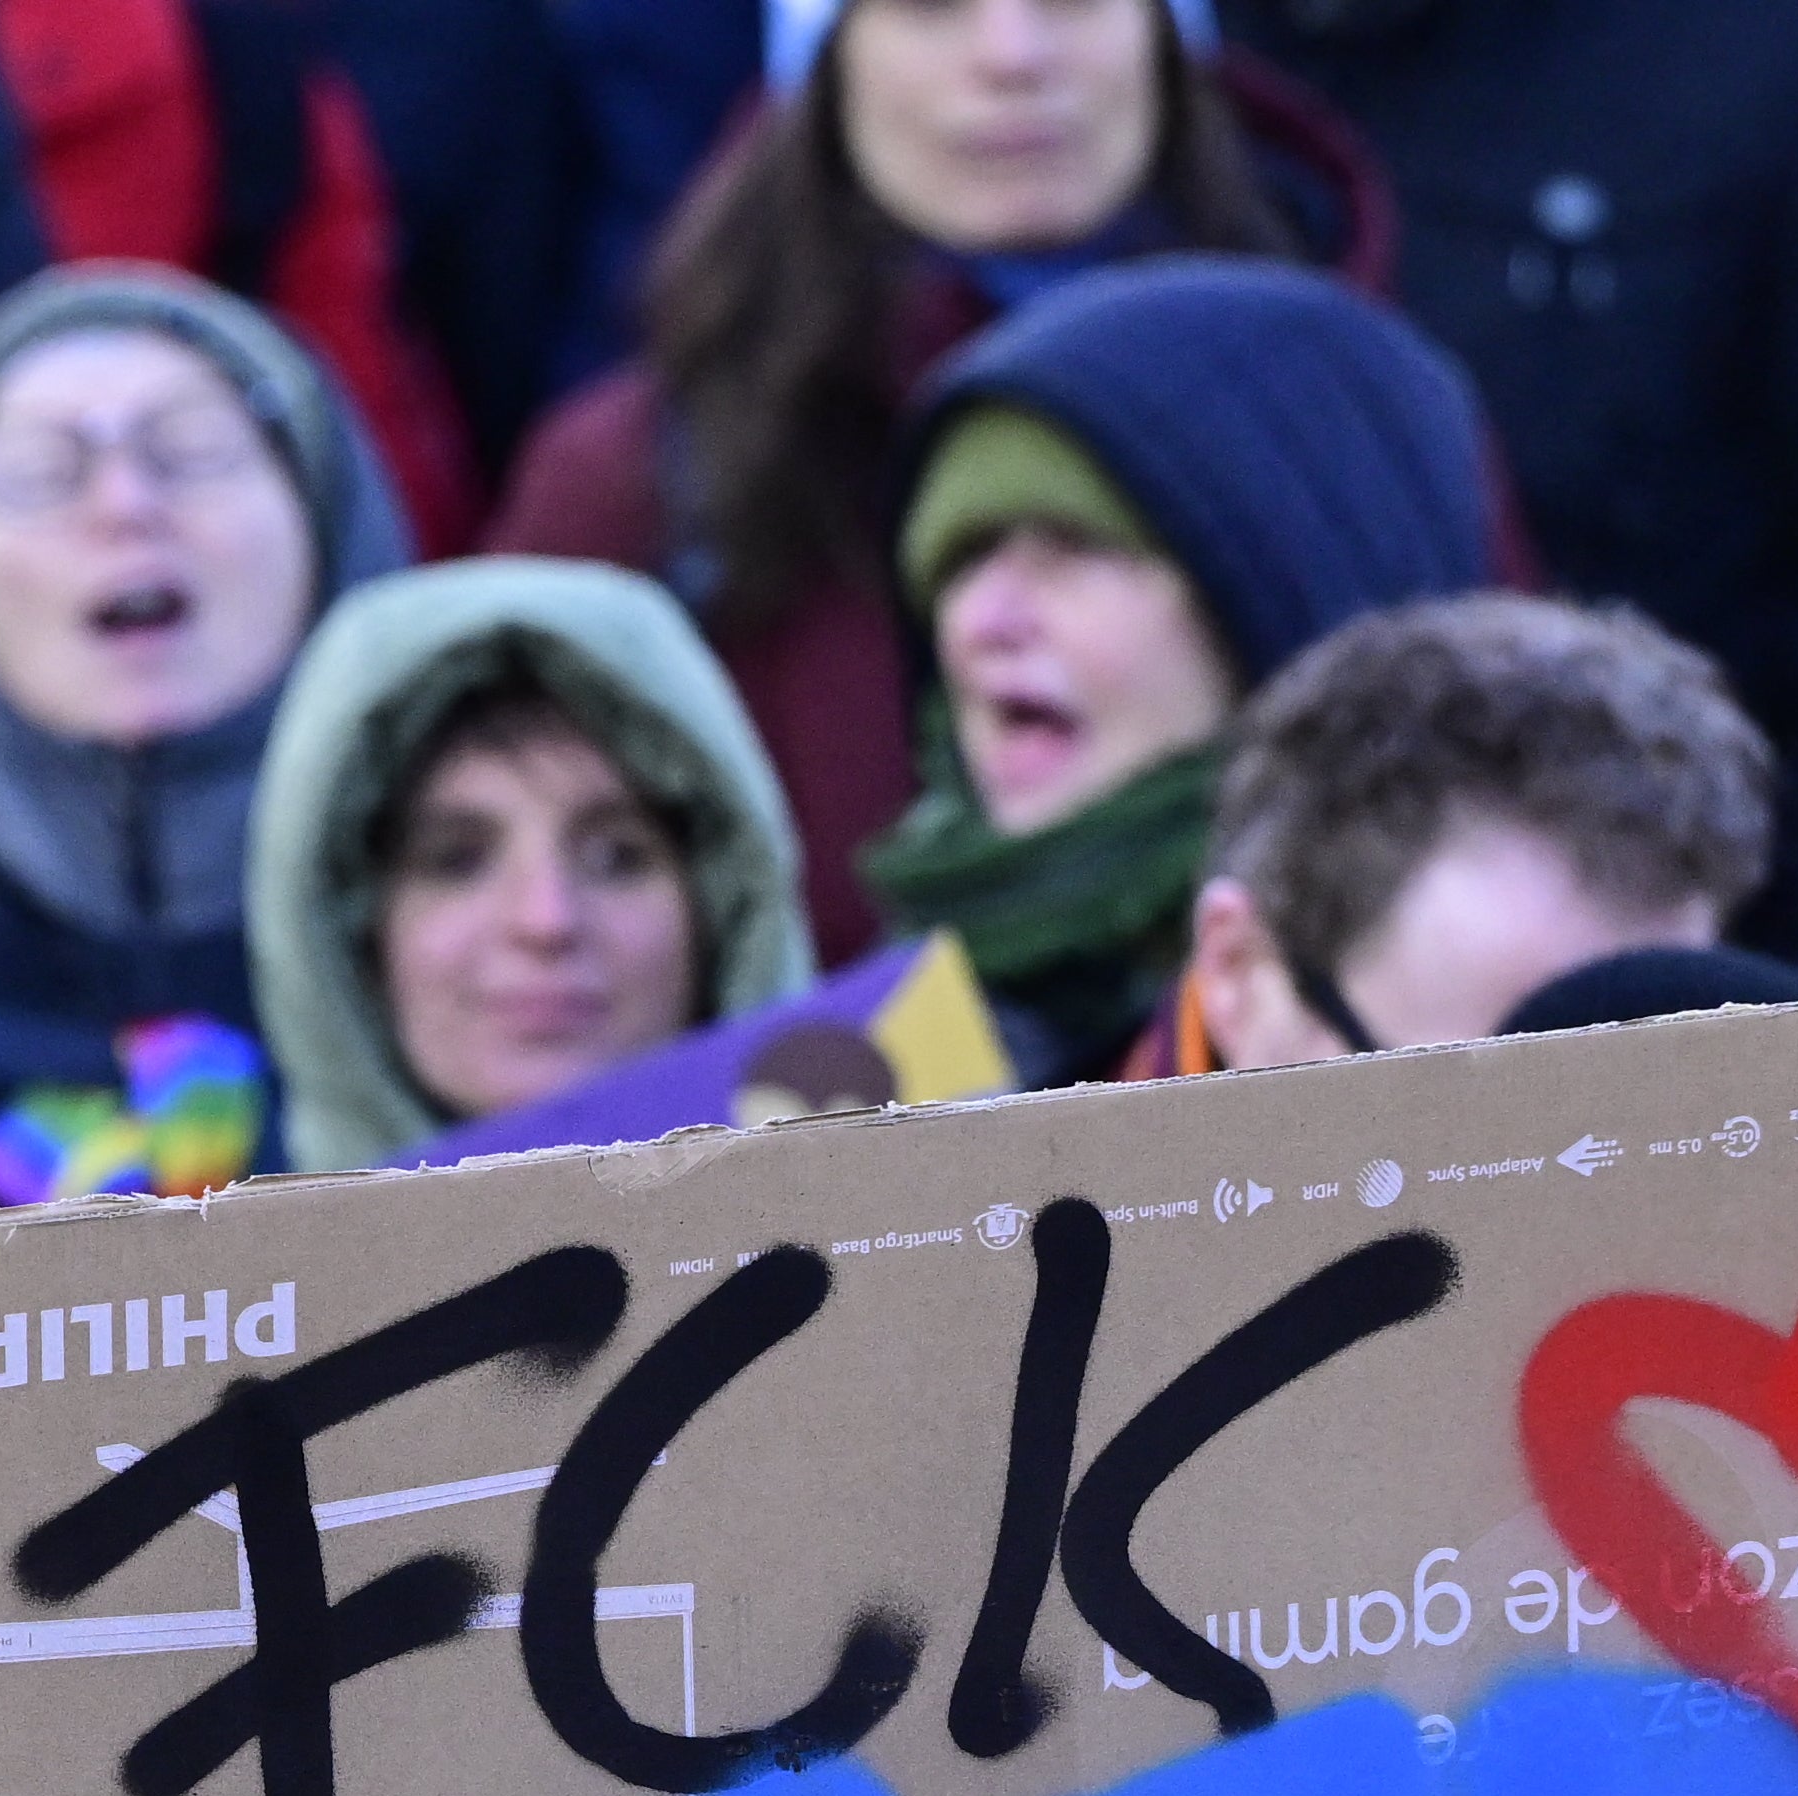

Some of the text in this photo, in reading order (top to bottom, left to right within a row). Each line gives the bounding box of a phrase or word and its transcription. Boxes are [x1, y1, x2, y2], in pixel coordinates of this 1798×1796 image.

[1649, 1137, 1702, 1154] 0.5 ms
[1427, 1156, 1546, 1182] Adaptive Sync
[1302, 1182, 1339, 1201] HDR
[1138, 1199, 1199, 1221] Built-in
[831, 1227, 963, 1255] SmartErgo Base
[669, 1257, 714, 1276] HDMI
[1504, 1566, 1619, 1654] de
